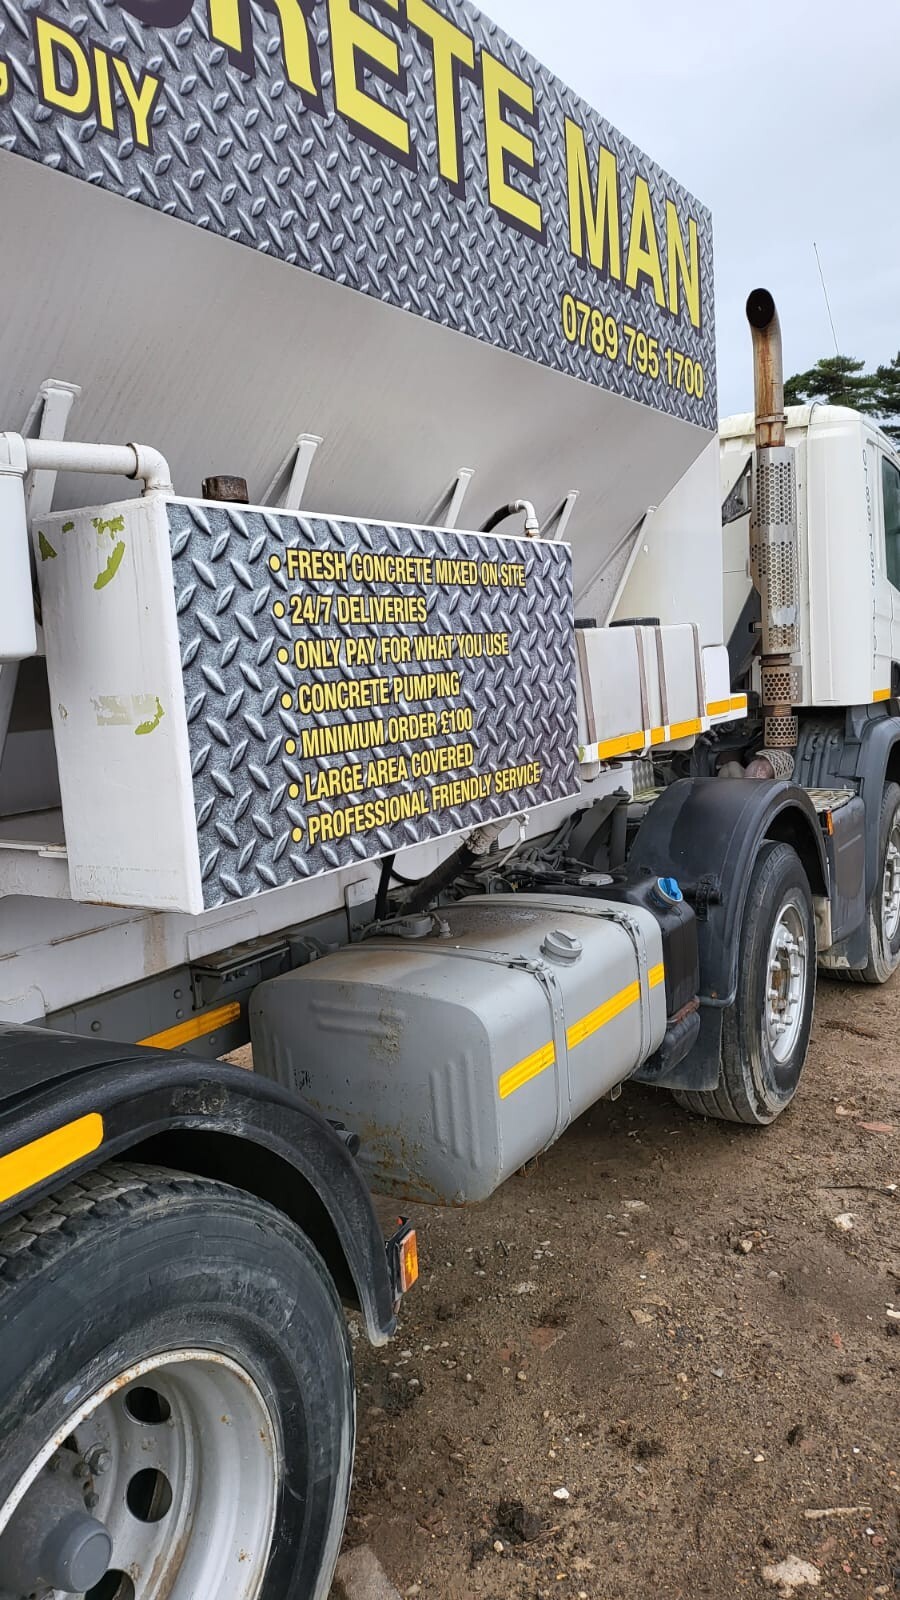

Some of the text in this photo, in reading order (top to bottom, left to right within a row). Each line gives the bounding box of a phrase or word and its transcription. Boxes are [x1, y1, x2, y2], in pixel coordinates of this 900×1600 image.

[36, 17, 159, 147] DIY
[564, 119, 701, 327] MAN
[562, 294, 704, 397] 0789 795 1700
[286, 549, 525, 587] FRESH CONCRETE MIXED ON SITE
[290, 595, 428, 624] 24/7 DELIVERIES
[294, 632, 508, 670] ONLY PAY FOR WHAT YOU USE
[298, 672, 460, 714] CONCRETE PUMPING
[301, 707, 473, 758] MINIMUM ORDER £100
[304, 743, 474, 802] LARGE AREA COVERED
[308, 761, 541, 845] PROFESSIONAL FRIENDLY SERVICE
